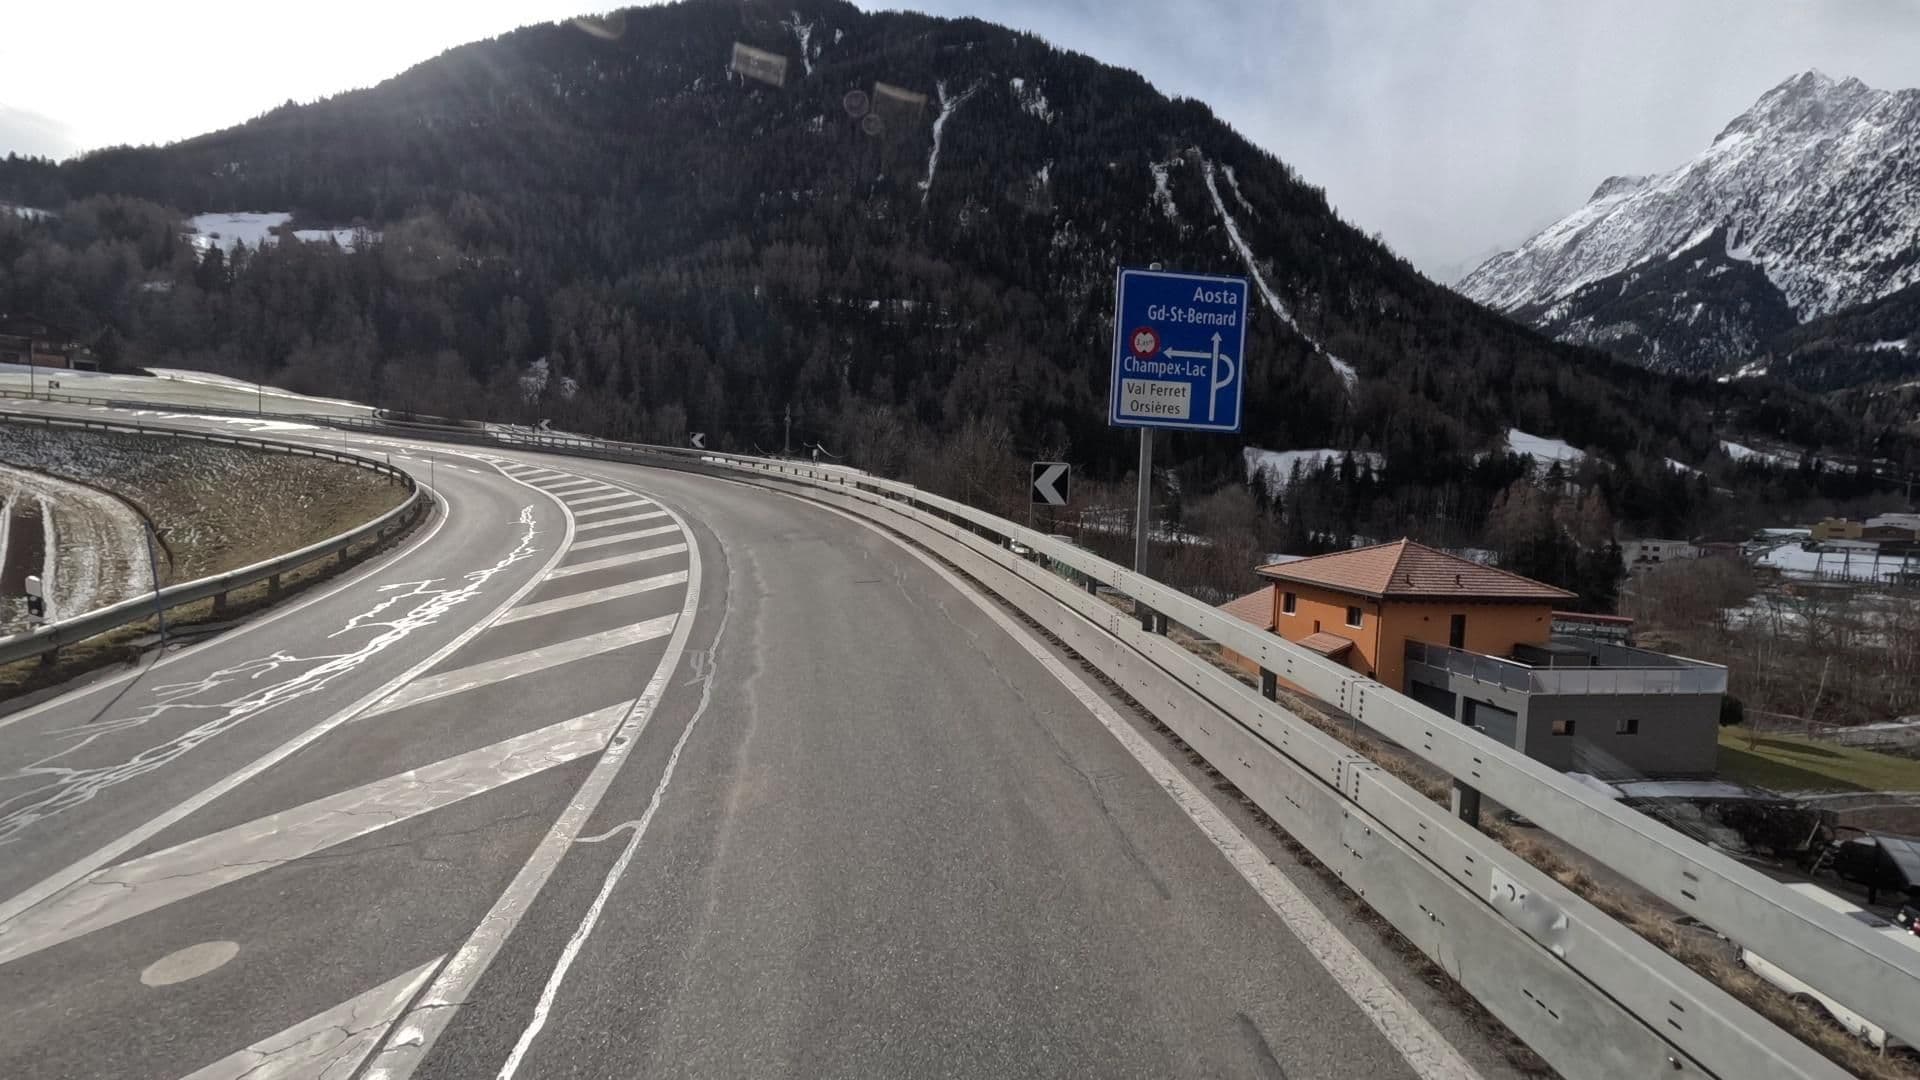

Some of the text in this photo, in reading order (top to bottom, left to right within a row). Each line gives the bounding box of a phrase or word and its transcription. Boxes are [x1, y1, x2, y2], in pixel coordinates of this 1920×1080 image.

[1193, 287, 1237, 304] Aosta
[1148, 305, 1236, 326] Gd-St-Bernard
[1124, 356, 1206, 378] Champex-Lac
[1127, 382, 1186, 398] Val Ferret
[1130, 400, 1181, 414] Orsières
